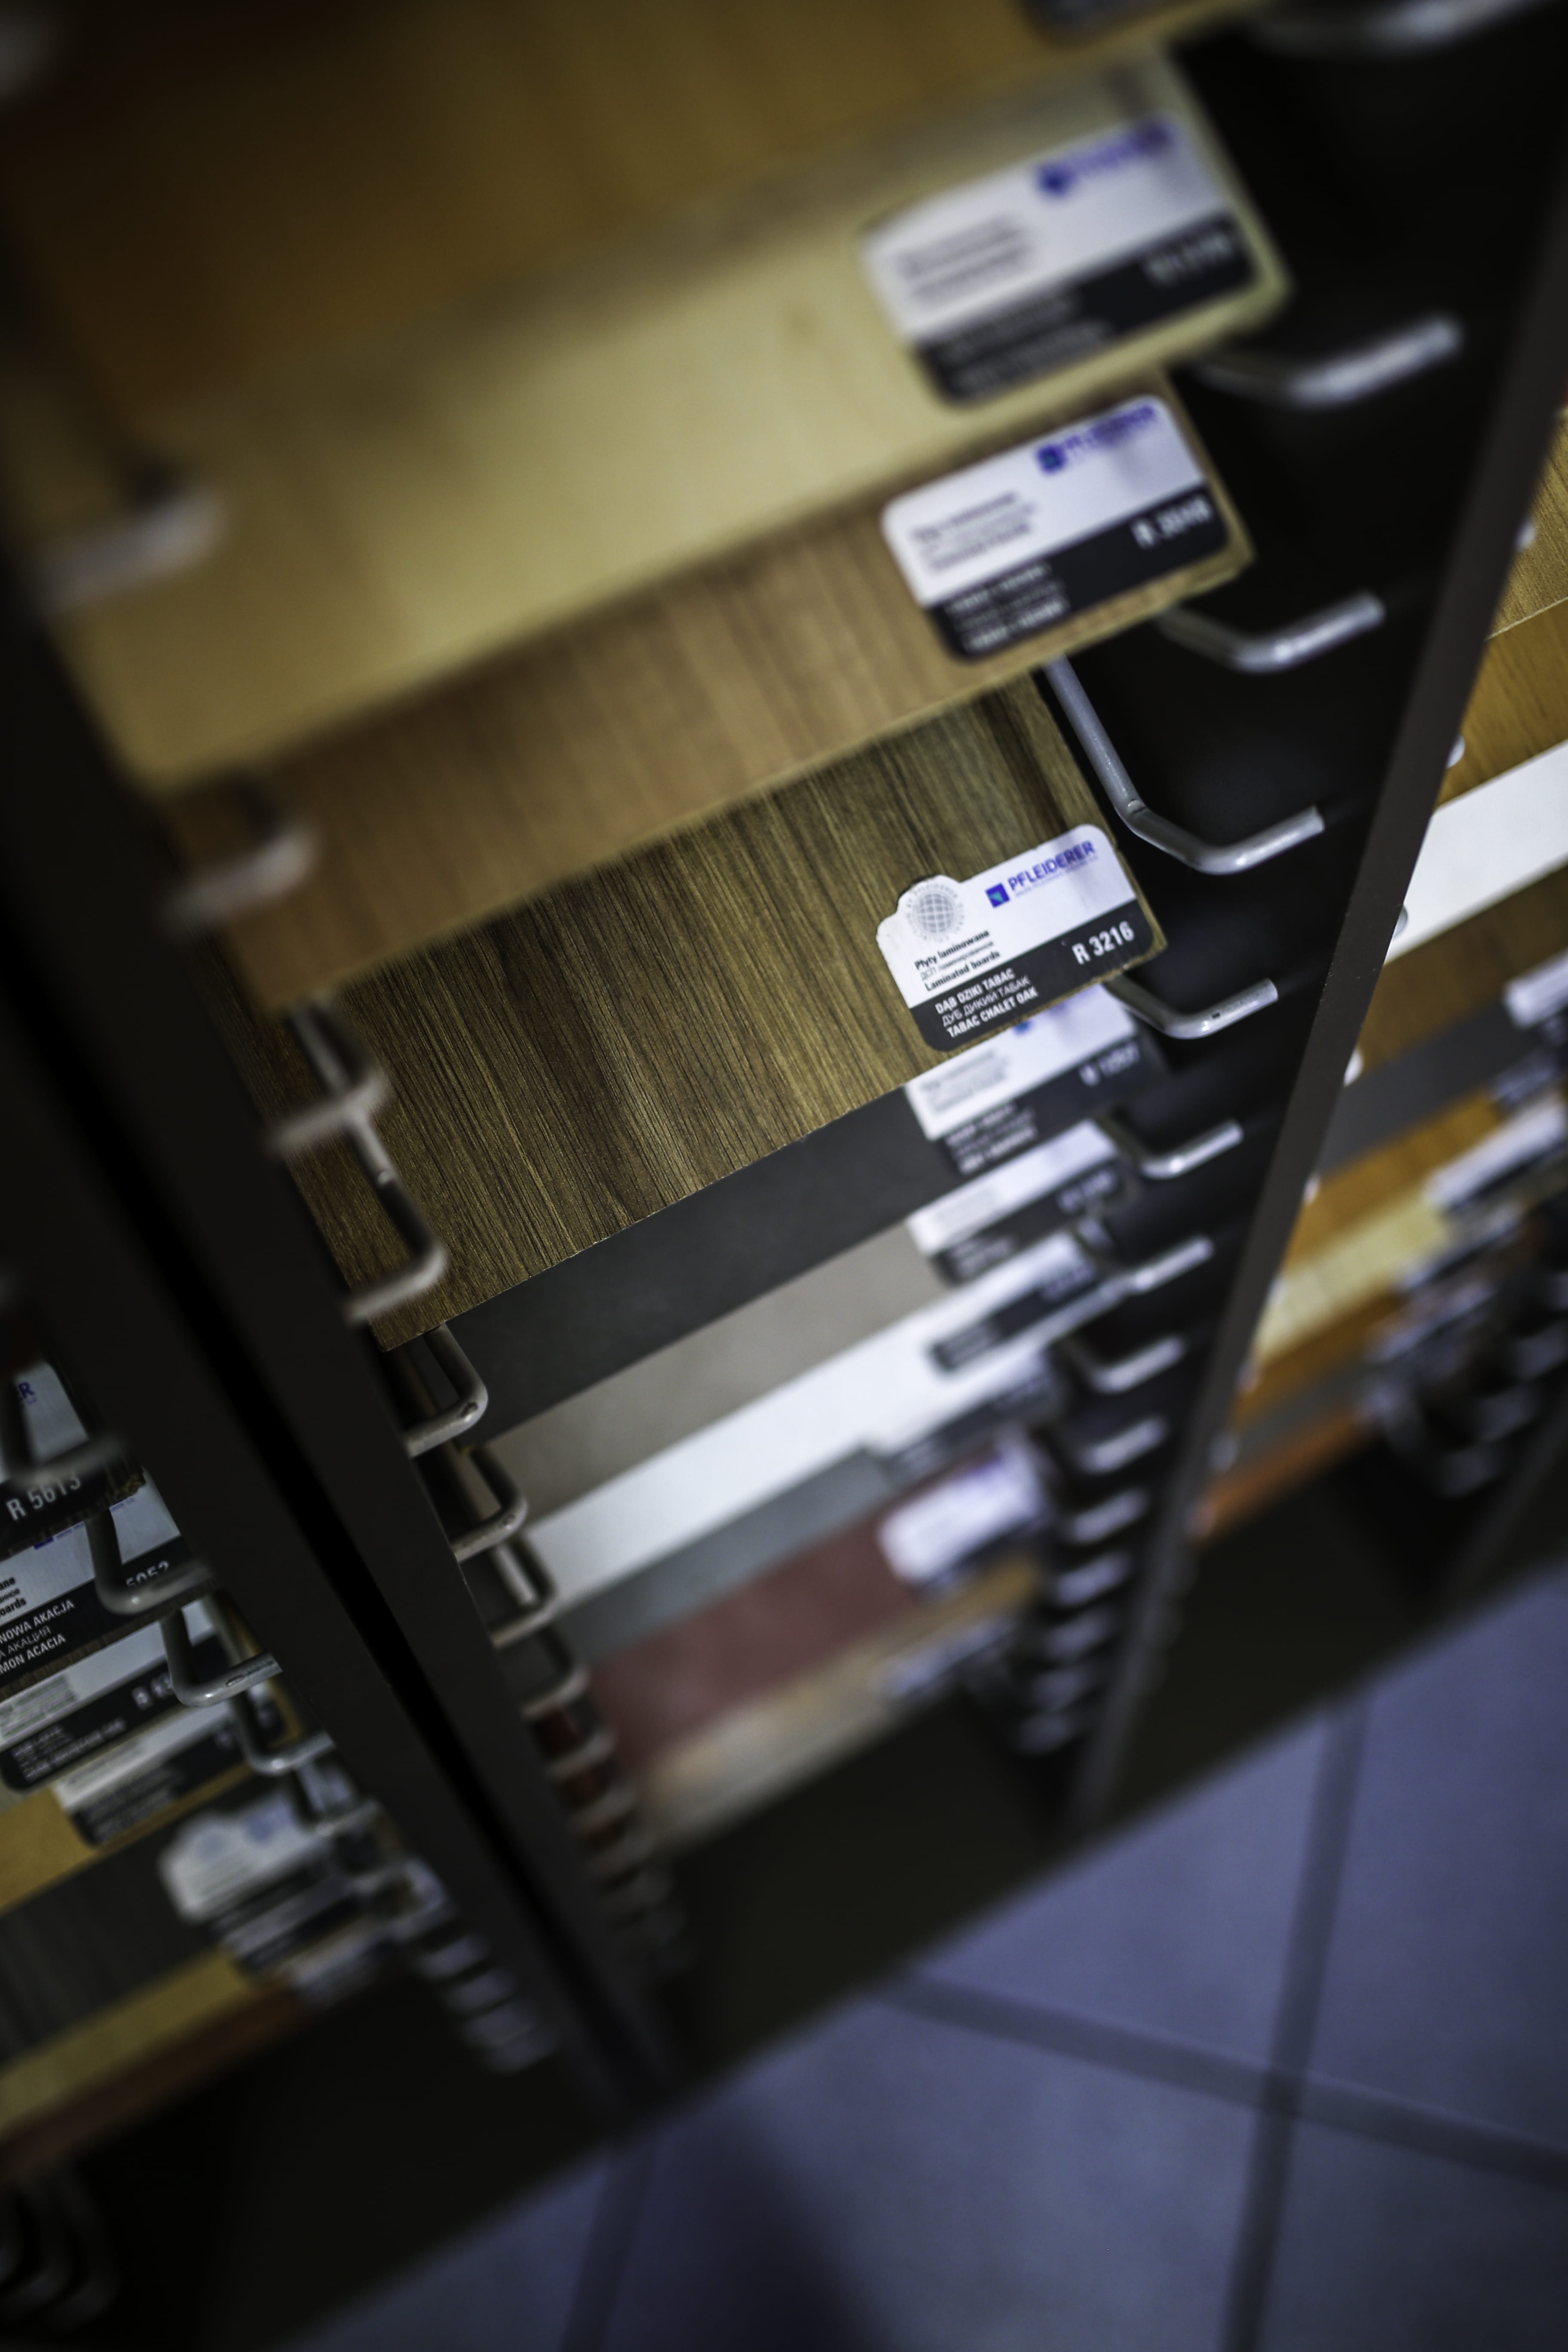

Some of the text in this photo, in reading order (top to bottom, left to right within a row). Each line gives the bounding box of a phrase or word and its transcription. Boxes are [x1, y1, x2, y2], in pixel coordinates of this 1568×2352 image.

[1008, 840, 1095, 890] PFLEIDERER
[1072, 921, 1134, 965] R 3216
[925, 951, 1000, 991] Laminated boards
[957, 984, 983, 1004] DZIKI
[982, 968, 1015, 990] TABAC
[942, 1009, 962, 1027] ДУБ
[946, 986, 1038, 1038] TABAC CHALET OAK
[6, 1498, 27, 1521] R
[33, 1599, 75, 1626] AKACJA
[26, 1634, 66, 1660] ACACIA
